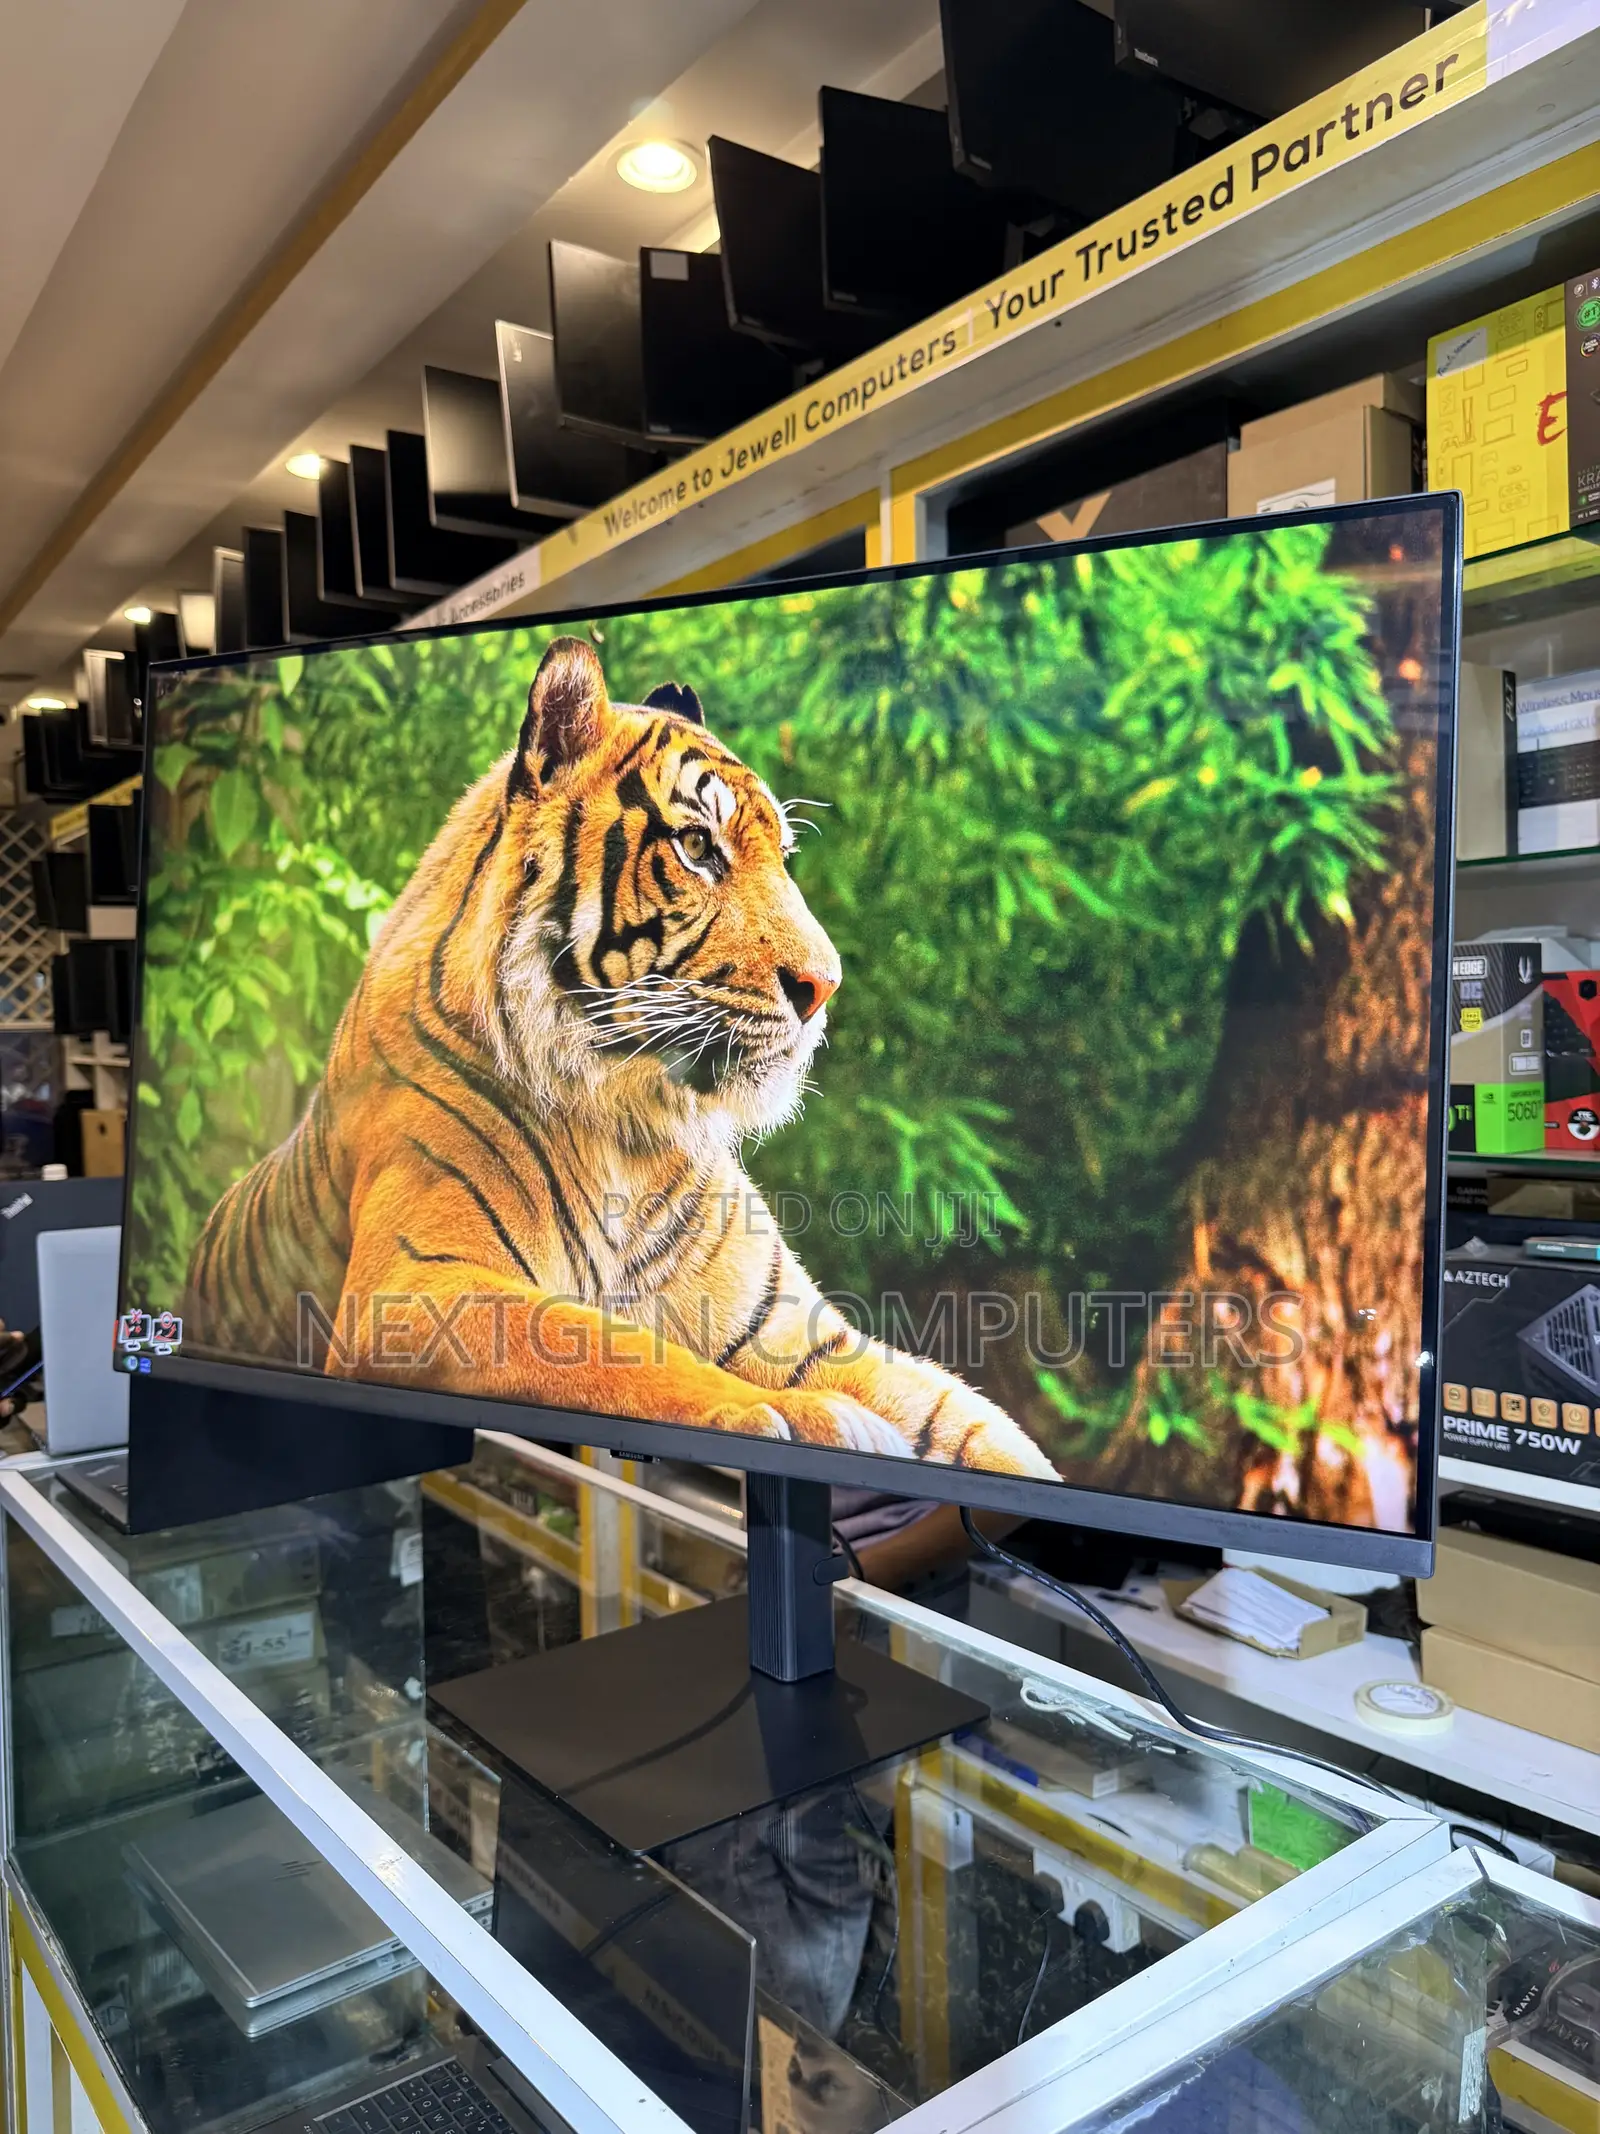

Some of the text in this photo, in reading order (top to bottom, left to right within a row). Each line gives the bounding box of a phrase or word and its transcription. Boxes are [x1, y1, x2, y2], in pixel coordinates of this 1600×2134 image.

[603, 51, 1460, 538] Welcome to Jewell Computers Your Trusted Partner
[450, 571, 526, 624] Accessories
[1517, 695, 1568, 713] Wireless
[1460, 959, 1484, 975] EDGE
[1454, 1270, 1510, 1288] AZTECH
[1443, 1415, 1582, 1455] PRIME 750W
[1513, 1985, 1539, 2015] HAVIT
[433, 2113, 444, 2123] W
